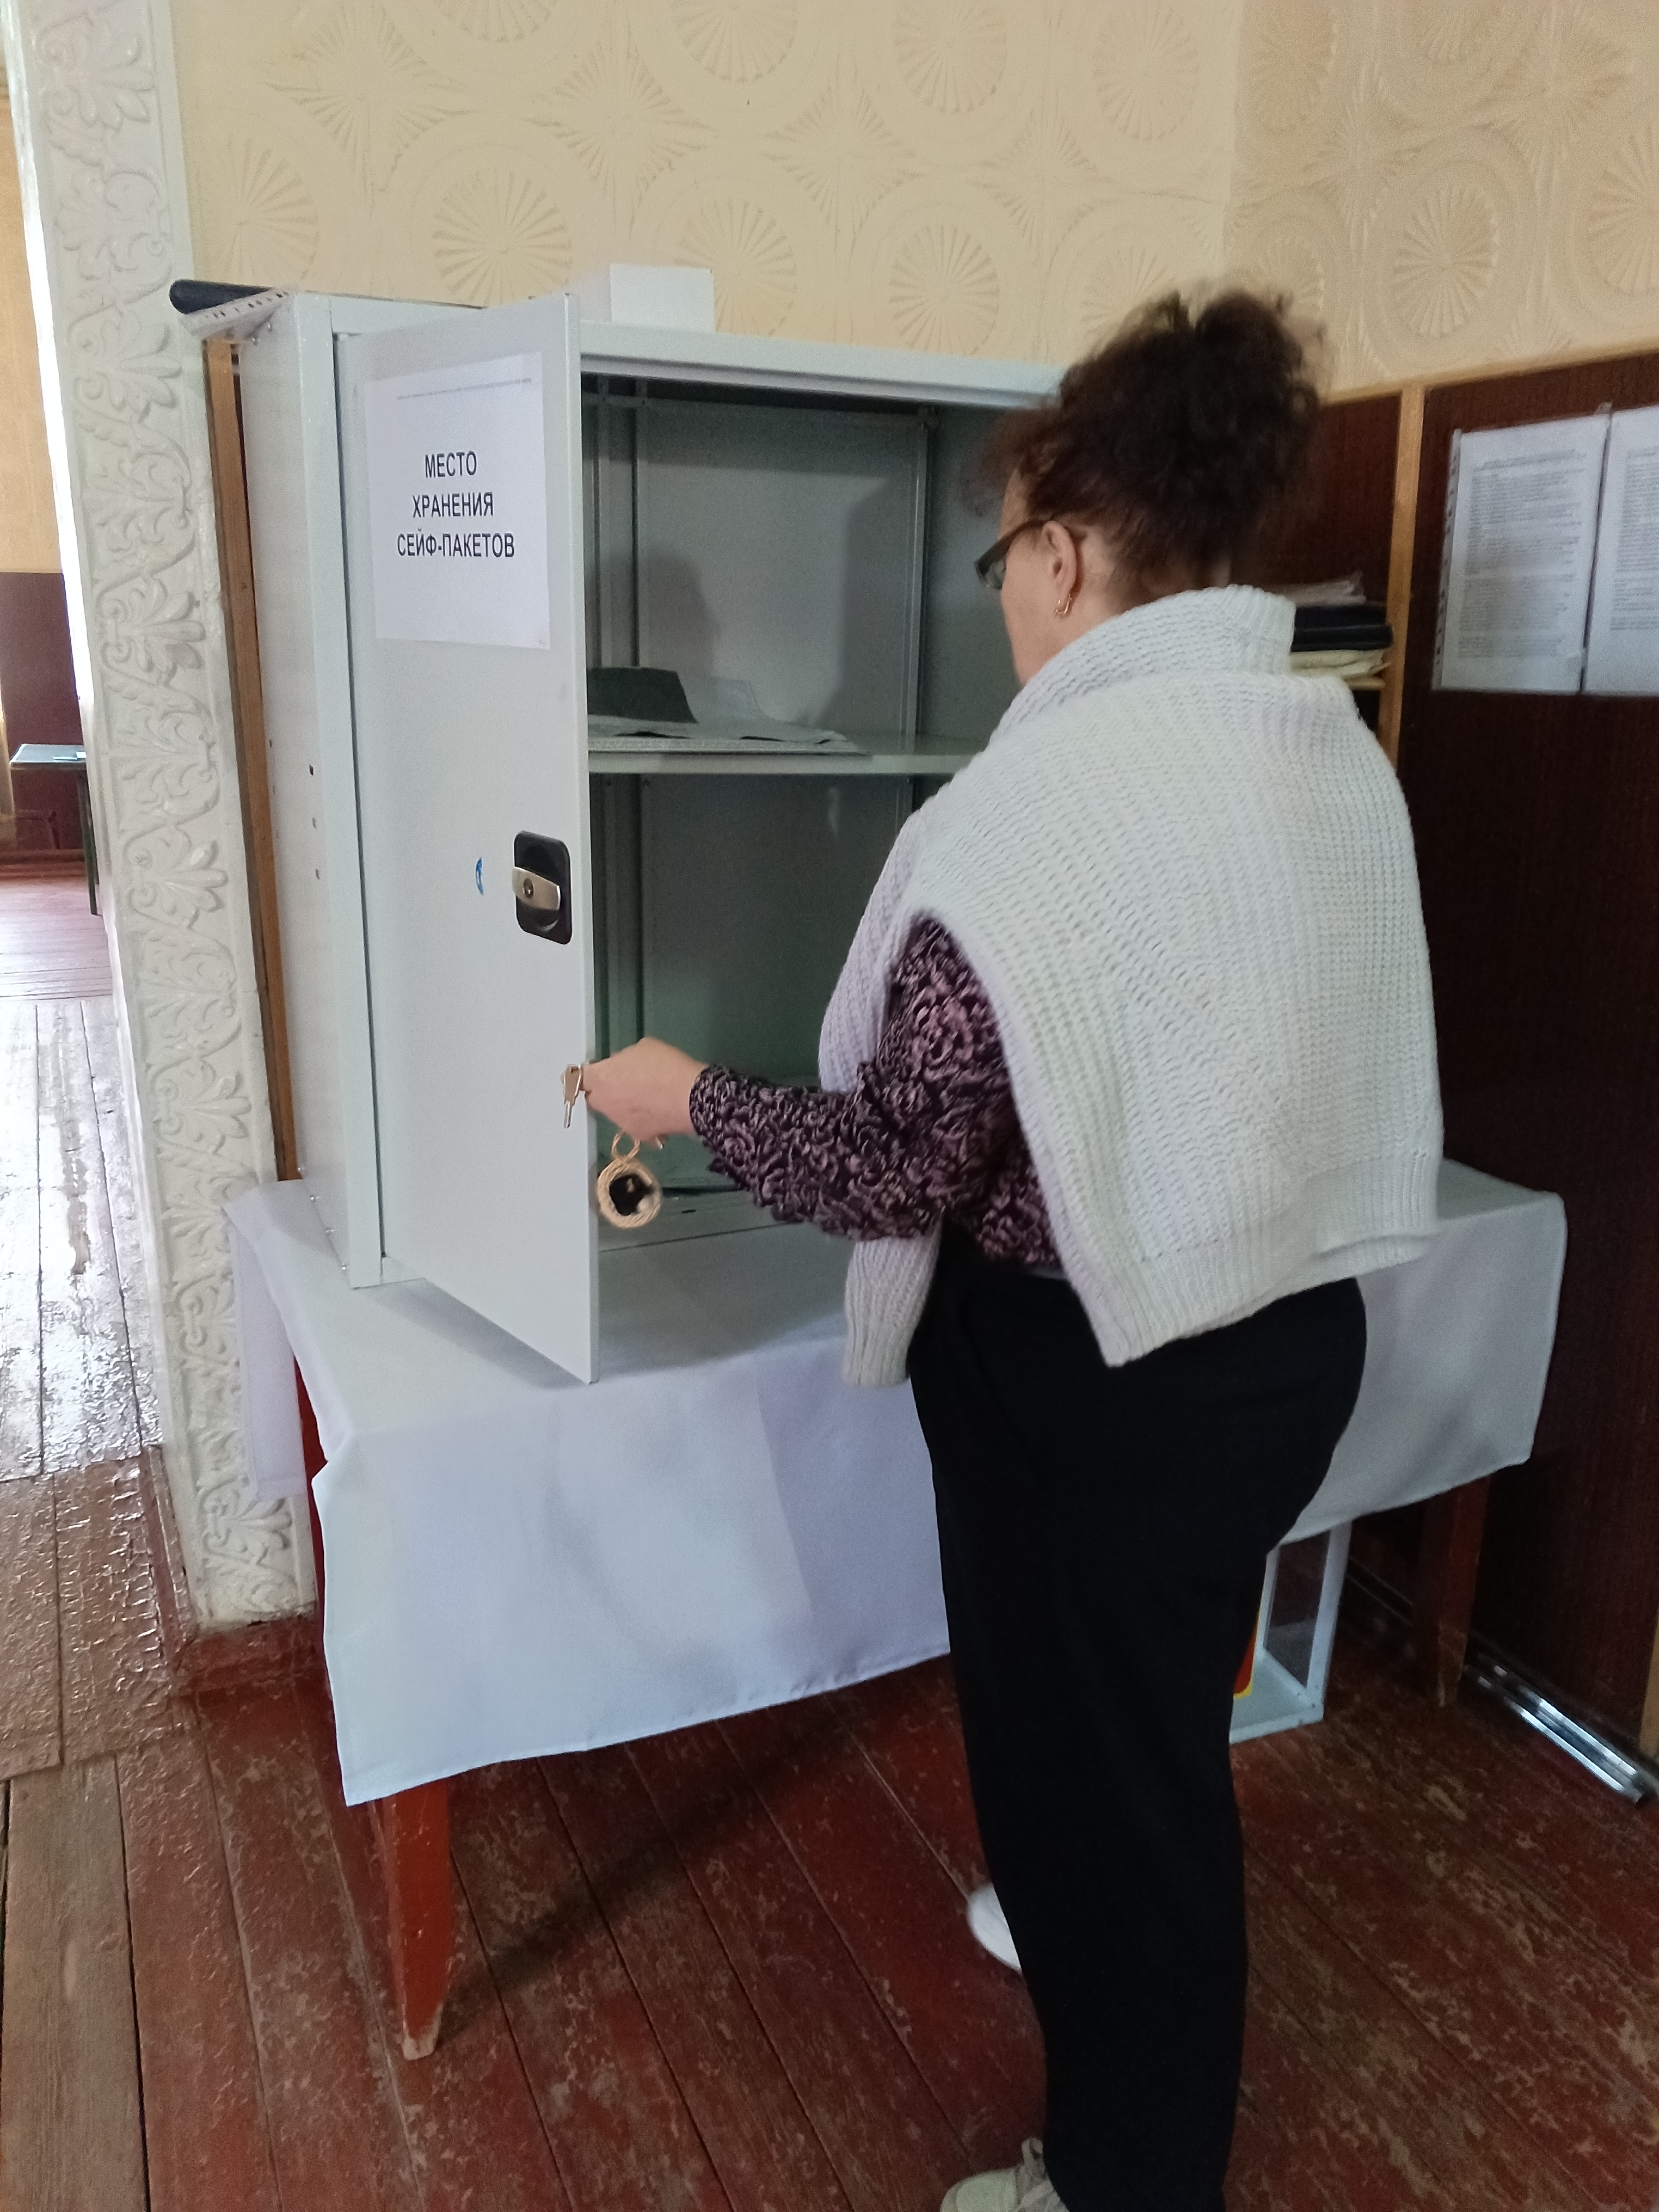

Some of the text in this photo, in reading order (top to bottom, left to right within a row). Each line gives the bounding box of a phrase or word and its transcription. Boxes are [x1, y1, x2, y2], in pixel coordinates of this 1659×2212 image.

[425, 450, 477, 478] МЕСТО
[412, 491, 494, 518] ХРАНЕНИЯ
[397, 527, 515, 558] СЕЙФ-ПАКЕТОВ
